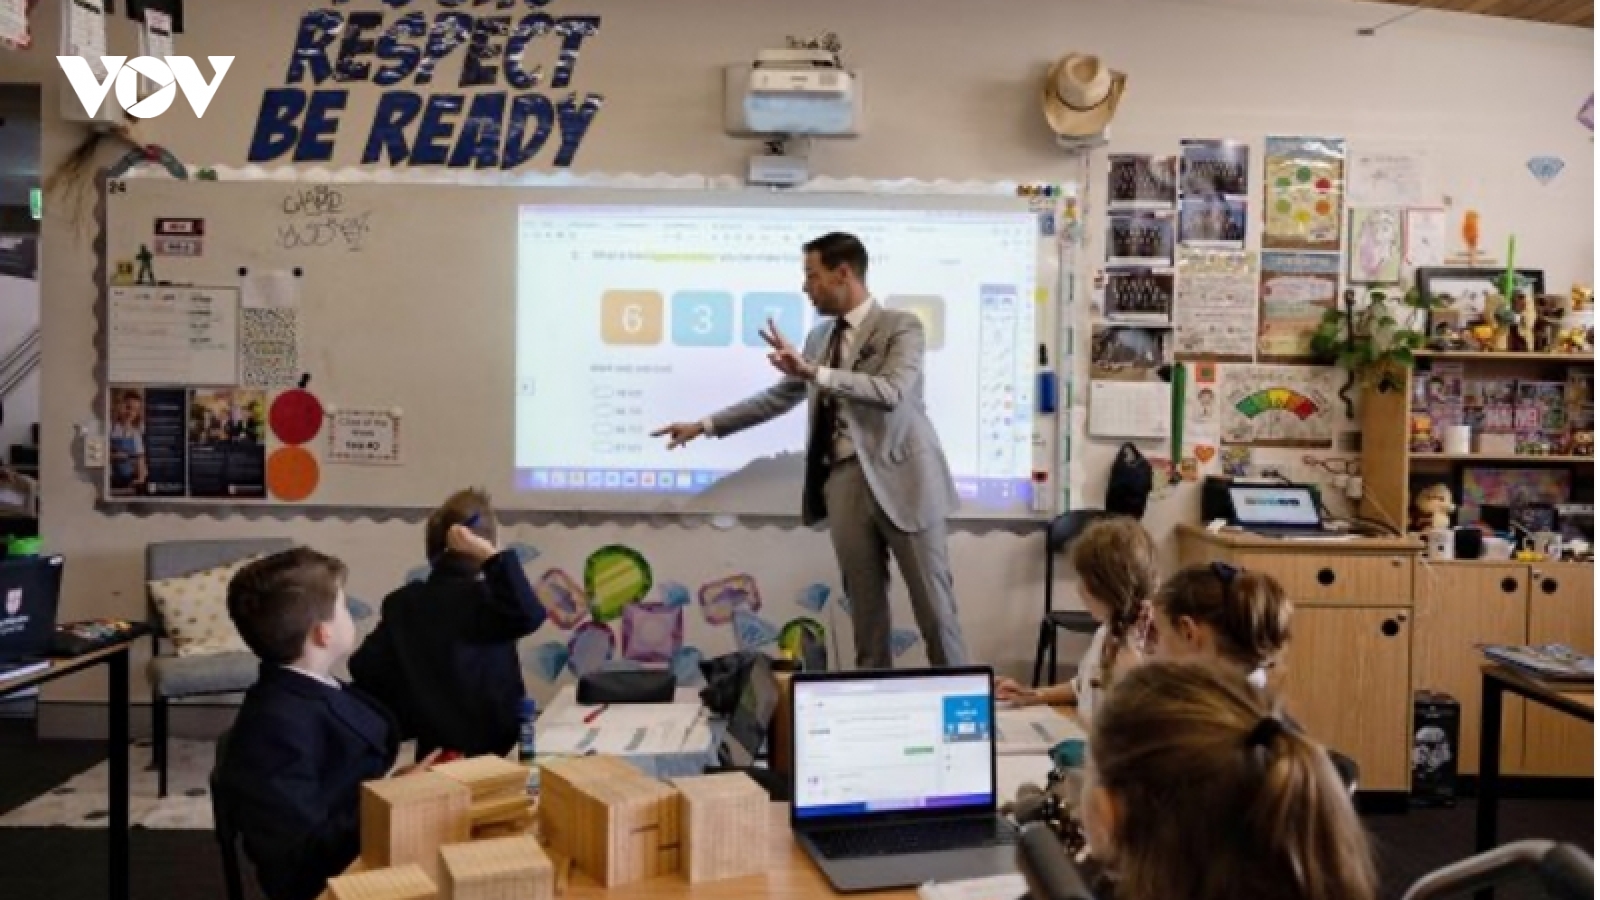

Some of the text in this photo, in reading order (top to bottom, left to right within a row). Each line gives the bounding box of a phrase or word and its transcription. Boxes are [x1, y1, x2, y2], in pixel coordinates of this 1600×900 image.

[285, 10, 602, 89] RESPECT
[247, 87, 604, 170] BE READY
[620, 304, 643, 335] 6
[691, 304, 713, 335] 3
